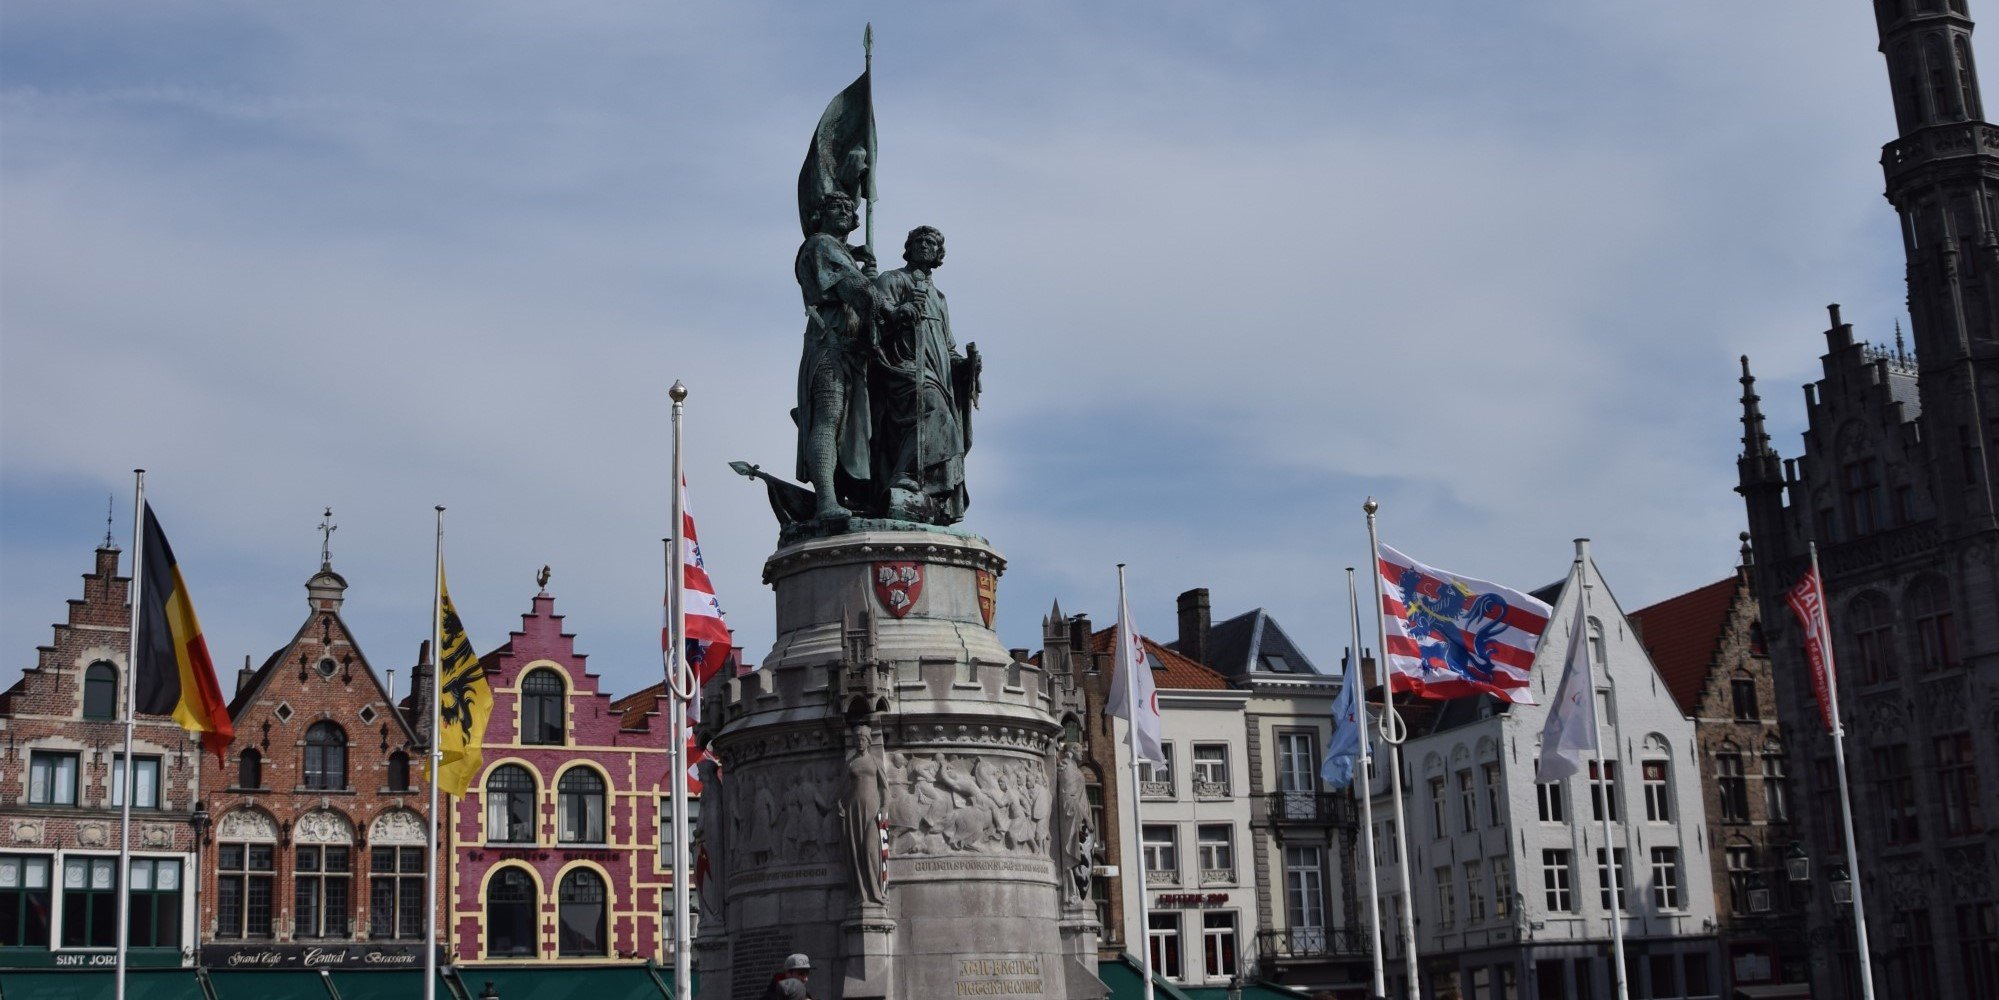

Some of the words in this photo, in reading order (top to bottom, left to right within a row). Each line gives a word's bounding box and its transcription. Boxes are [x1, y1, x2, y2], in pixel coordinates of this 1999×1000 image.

[56, 955, 85, 965] SINT
[89, 955, 118, 965] JORI
[228, 952, 260, 966] Grand
[304, 948, 346, 966] Central
[365, 952, 416, 964] Brasserie
